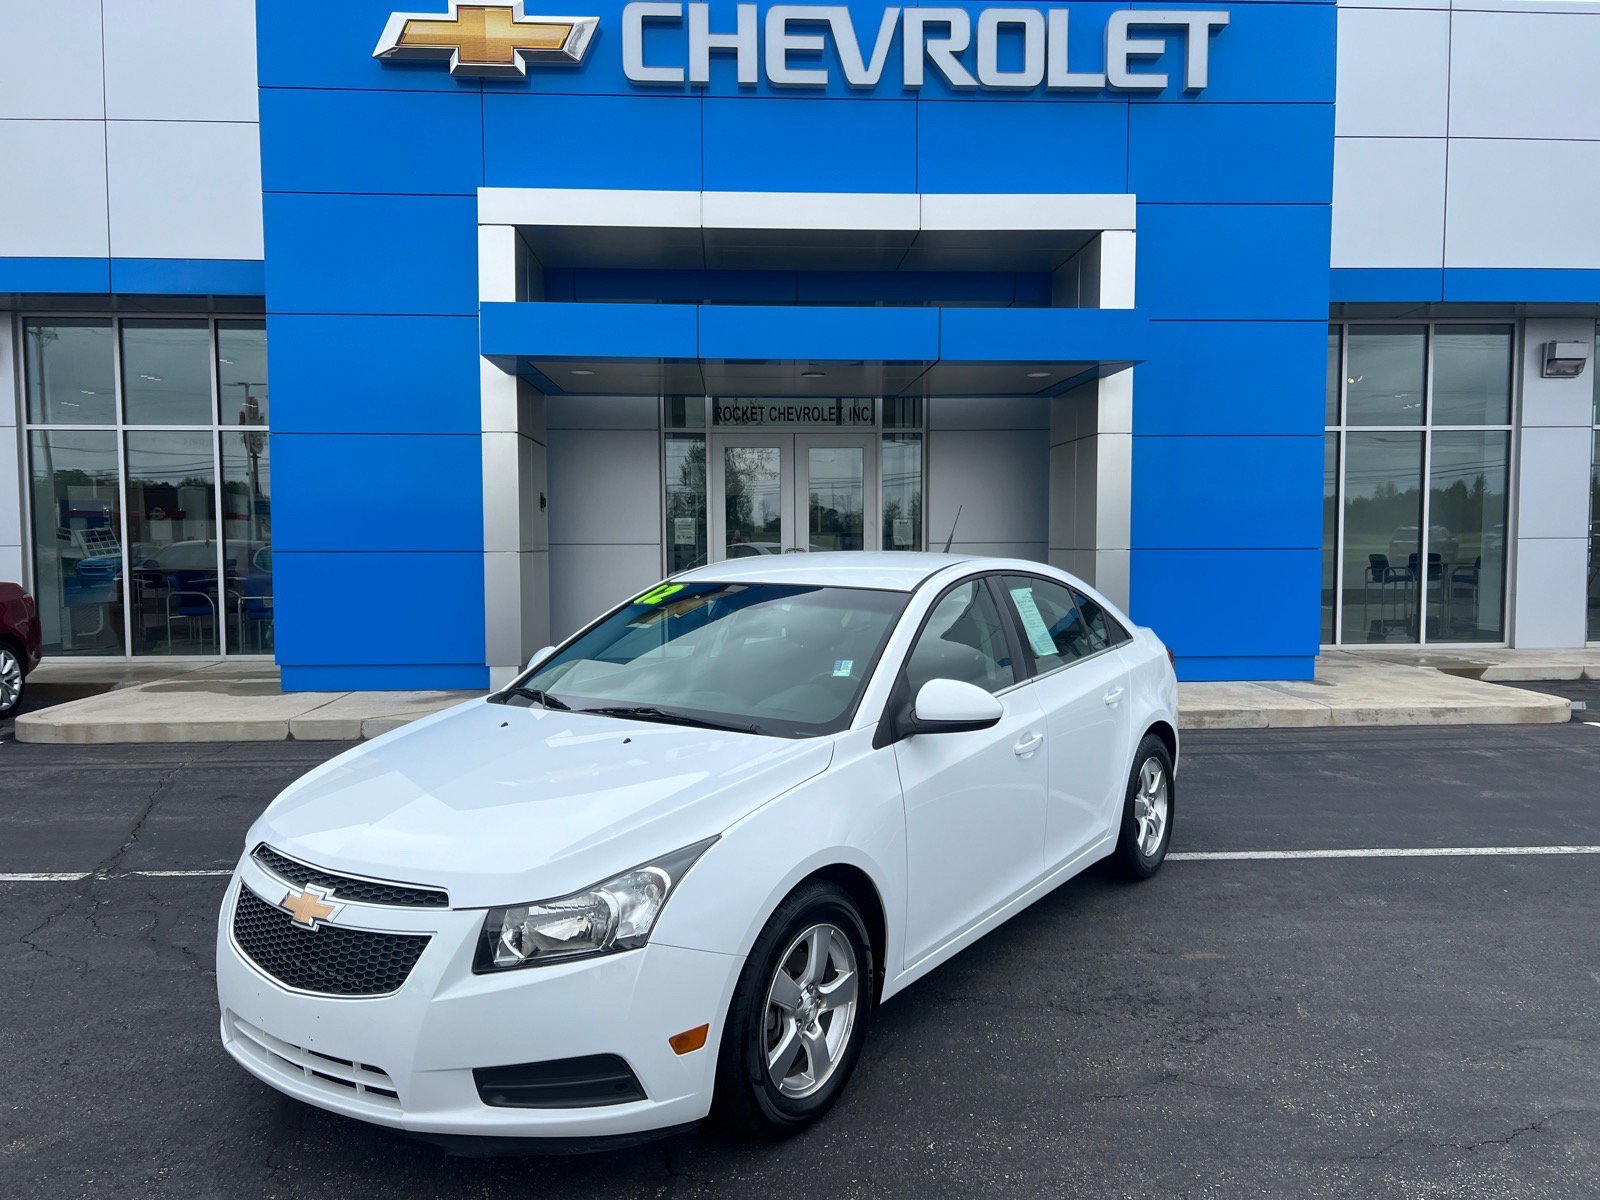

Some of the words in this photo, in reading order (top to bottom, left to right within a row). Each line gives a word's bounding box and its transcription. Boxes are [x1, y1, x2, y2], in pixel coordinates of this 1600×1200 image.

[622, 2, 1230, 93] CHEVROLET
[715, 406, 766, 422] ROCKET
[769, 406, 845, 424] CHEVROLET,
